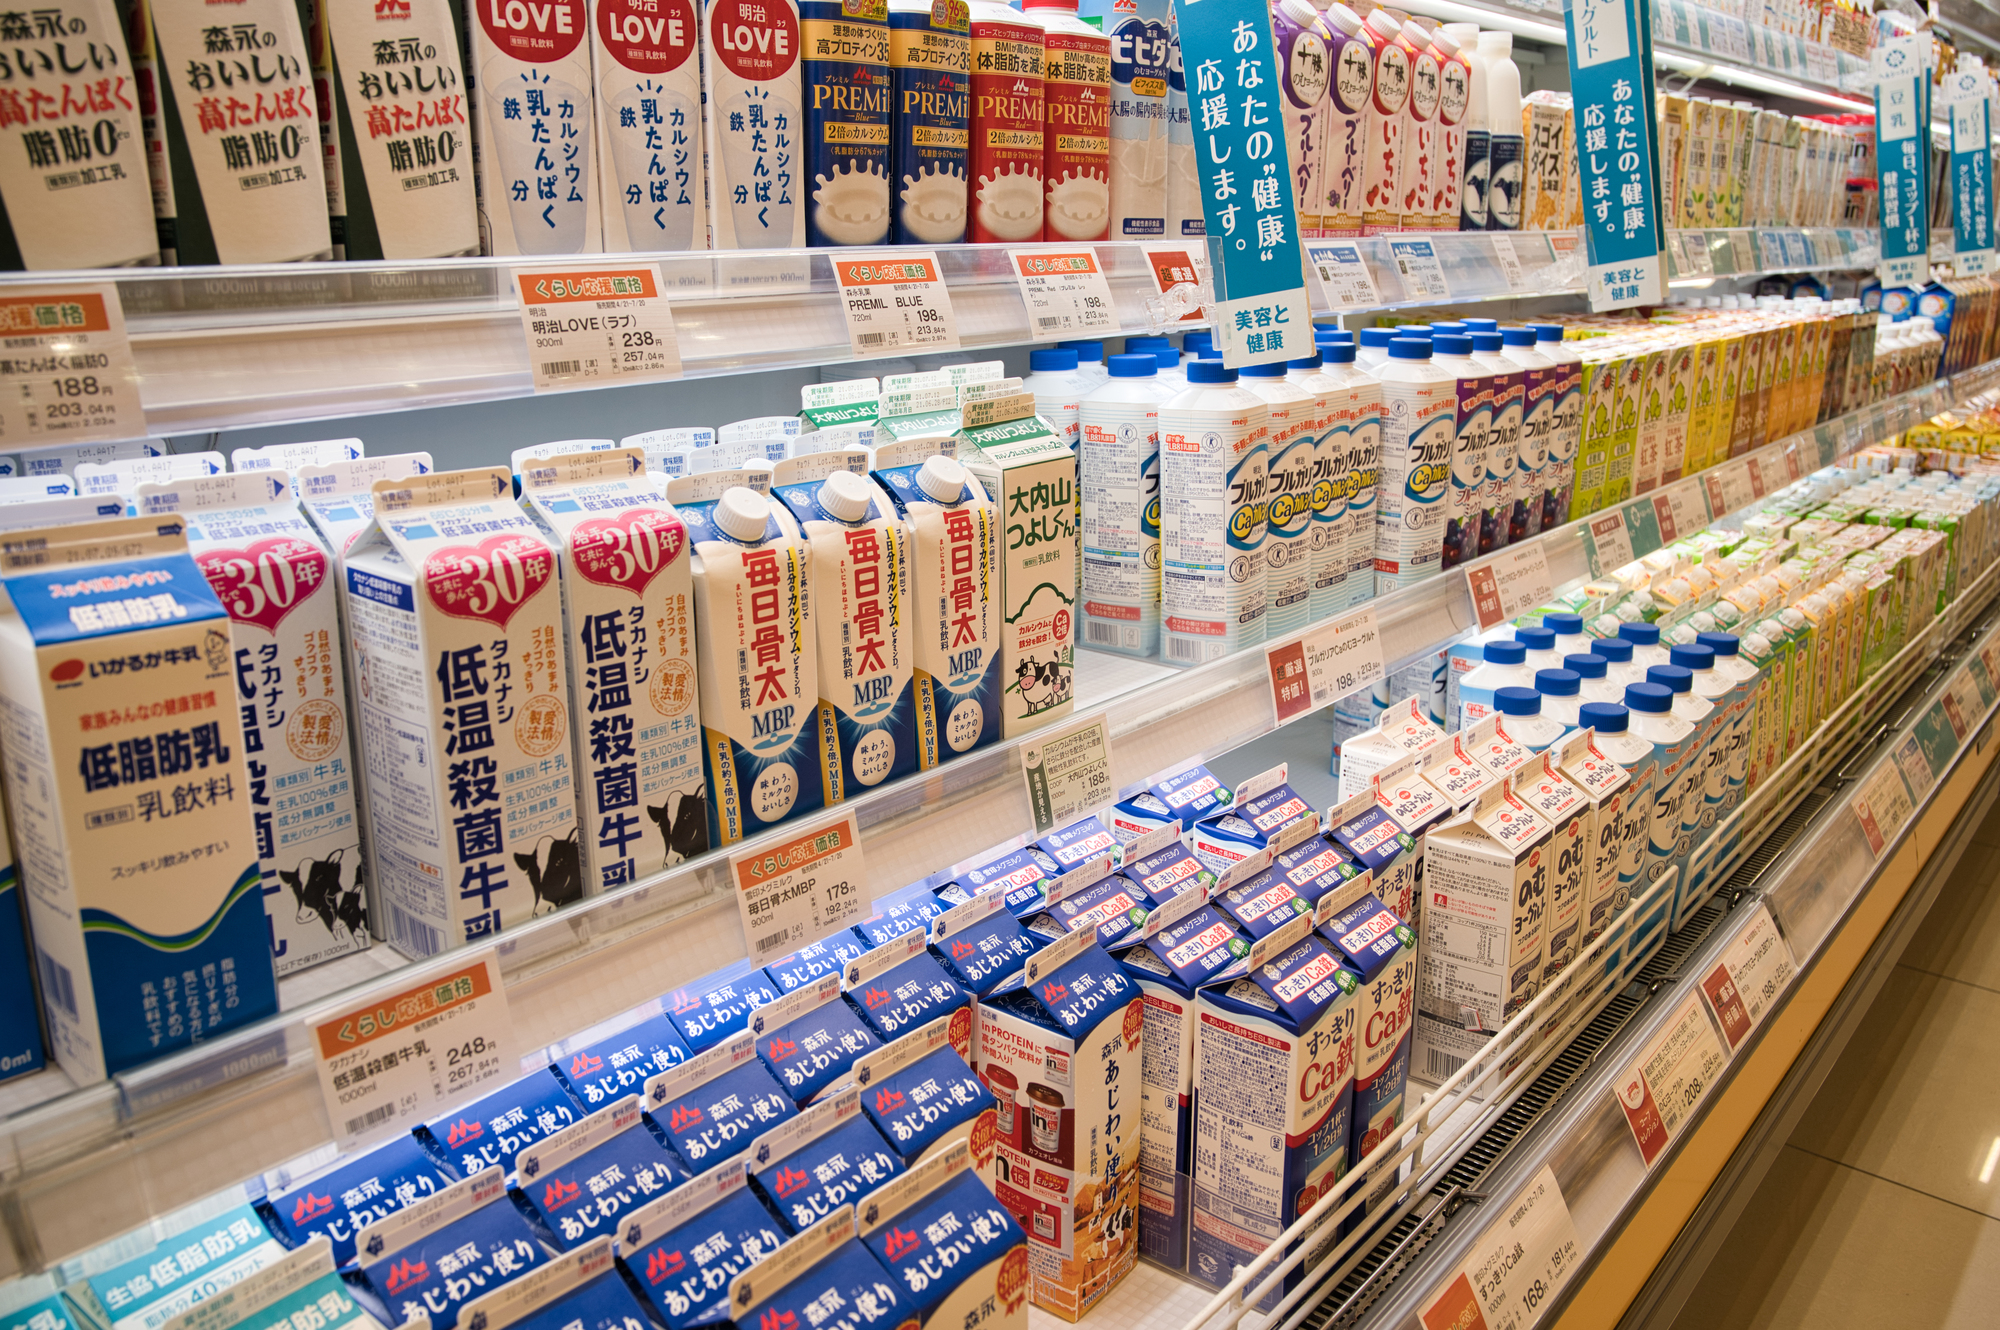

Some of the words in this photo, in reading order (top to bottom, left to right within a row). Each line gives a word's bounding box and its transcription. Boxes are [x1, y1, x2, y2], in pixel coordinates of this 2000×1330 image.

[491, 0, 572, 34] LOVE
[609, 12, 684, 46] LOVE
[739, 4, 766, 22] 明治
[203, 24, 277, 54] 森永の
[373, 38, 436, 66] 森永の
[722, 26, 788, 55] LOVE
[833, 25, 887, 41] 理想の体づくりに
[995, 42, 1043, 56] BMIが高めの方の
[186, 54, 301, 93] おいしい
[358, 66, 456, 98] おいしい
[196, 86, 312, 132] 高たんぱく
[364, 95, 465, 138] 高たんぱく
[220, 125, 300, 169] 脂肪0
[386, 131, 453, 172] 脂肪0
[558, 100, 583, 202] カルシウム
[1196, 58, 1246, 251] 応援します。
[1533, 123, 1562, 150] スゴイ
[526, 89, 556, 228] 乳たんぱく
[641, 98, 666, 230] 乳たんぱく
[669, 108, 691, 205] カルシウム
[748, 104, 769, 228] 乳たんぱく
[774, 113, 792, 205] カルシウム
[1381, 120, 1396, 205] いちご
[1418, 127, 1430, 207] いちご
[1532, 149, 1562, 176] ダイズ
[1583, 104, 1616, 233] 応援します。
[536, 278, 642, 297] くらし応援価格
[849, 263, 927, 282] くらし応援価格
[1603, 267, 1645, 286] 美容と
[529, 308, 547, 317] 明治
[849, 299, 888, 311] PREMIL
[896, 296, 923, 307] BLUE
[1611, 286, 1640, 301] 健康
[1235, 304, 1289, 331] 美容と
[536, 338, 563, 347] 900ml
[1246, 331, 1284, 354] 健康
[1232, 417, 1248, 426] meiji
[1272, 410, 1289, 419] meiji
[1009, 477, 1071, 517] 大内山
[1273, 500, 1291, 518] Ca
[1007, 509, 1075, 550] つよしくん
[1234, 510, 1251, 531] Ca
[603, 523, 658, 581] 30
[660, 530, 680, 553] 年
[460, 548, 525, 614] 30
[525, 556, 547, 582] 年
[942, 509, 976, 648] 毎日骨太
[844, 528, 886, 676] 毎日骨太
[1055, 614, 1067, 625] Ca
[629, 606, 649, 684] タカナシ
[742, 549, 787, 706] 毎日骨太
[1056, 626, 1067, 637] 2倍
[491, 640, 514, 724] タカナシ
[1281, 680, 1303, 702] 特価!
[640, 725, 667, 740] 種類別
[670, 715, 696, 733] 牛乳
[79, 721, 230, 792] 低脂肪乳
[640, 735, 697, 762] 生乳100%使用
[642, 754, 686, 777] 成分無調整
[137, 774, 234, 822] 乳飲料
[751, 832, 840, 877] くらし応援価格
[1289, 851, 1341, 885] すっきりCa鉄
[1558, 837, 1583, 875] のむ
[748, 878, 816, 915] 毎日骨太MBP
[1315, 871, 1341, 889] 低脂肪
[1519, 864, 1545, 907] のむ
[1554, 868, 1583, 901] ヨーグルト
[751, 913, 774, 928] 900ml
[1515, 896, 1546, 935] ヨーグルト
[966, 935, 1034, 981] あじわい便り
[1172, 924, 1232, 964] すっきりCa鉄
[1200, 947, 1231, 971] 低脂肪
[894, 980, 922, 1001] 森永
[1070, 974, 1097, 994] 森永
[1278, 956, 1338, 998] すっきりCa鉄
[1307, 980, 1338, 1005] 低脂肪
[338, 977, 473, 1042] くらし応援価格
[684, 987, 775, 1037] あじわい便り
[881, 981, 956, 1032] あじわい便り
[1062, 973, 1129, 1026] あじわい便り
[1307, 1008, 1355, 1062] すっきり
[334, 1040, 430, 1091] 低温殺菌牛乳
[1301, 1033, 1355, 1102] Ca鉄
[892, 1079, 981, 1141] あじわい便り
[909, 1079, 942, 1104] 森永
[904, 1209, 1008, 1292] あじわい便り
[1479, 1242, 1525, 1301] すっきりCa鉄
